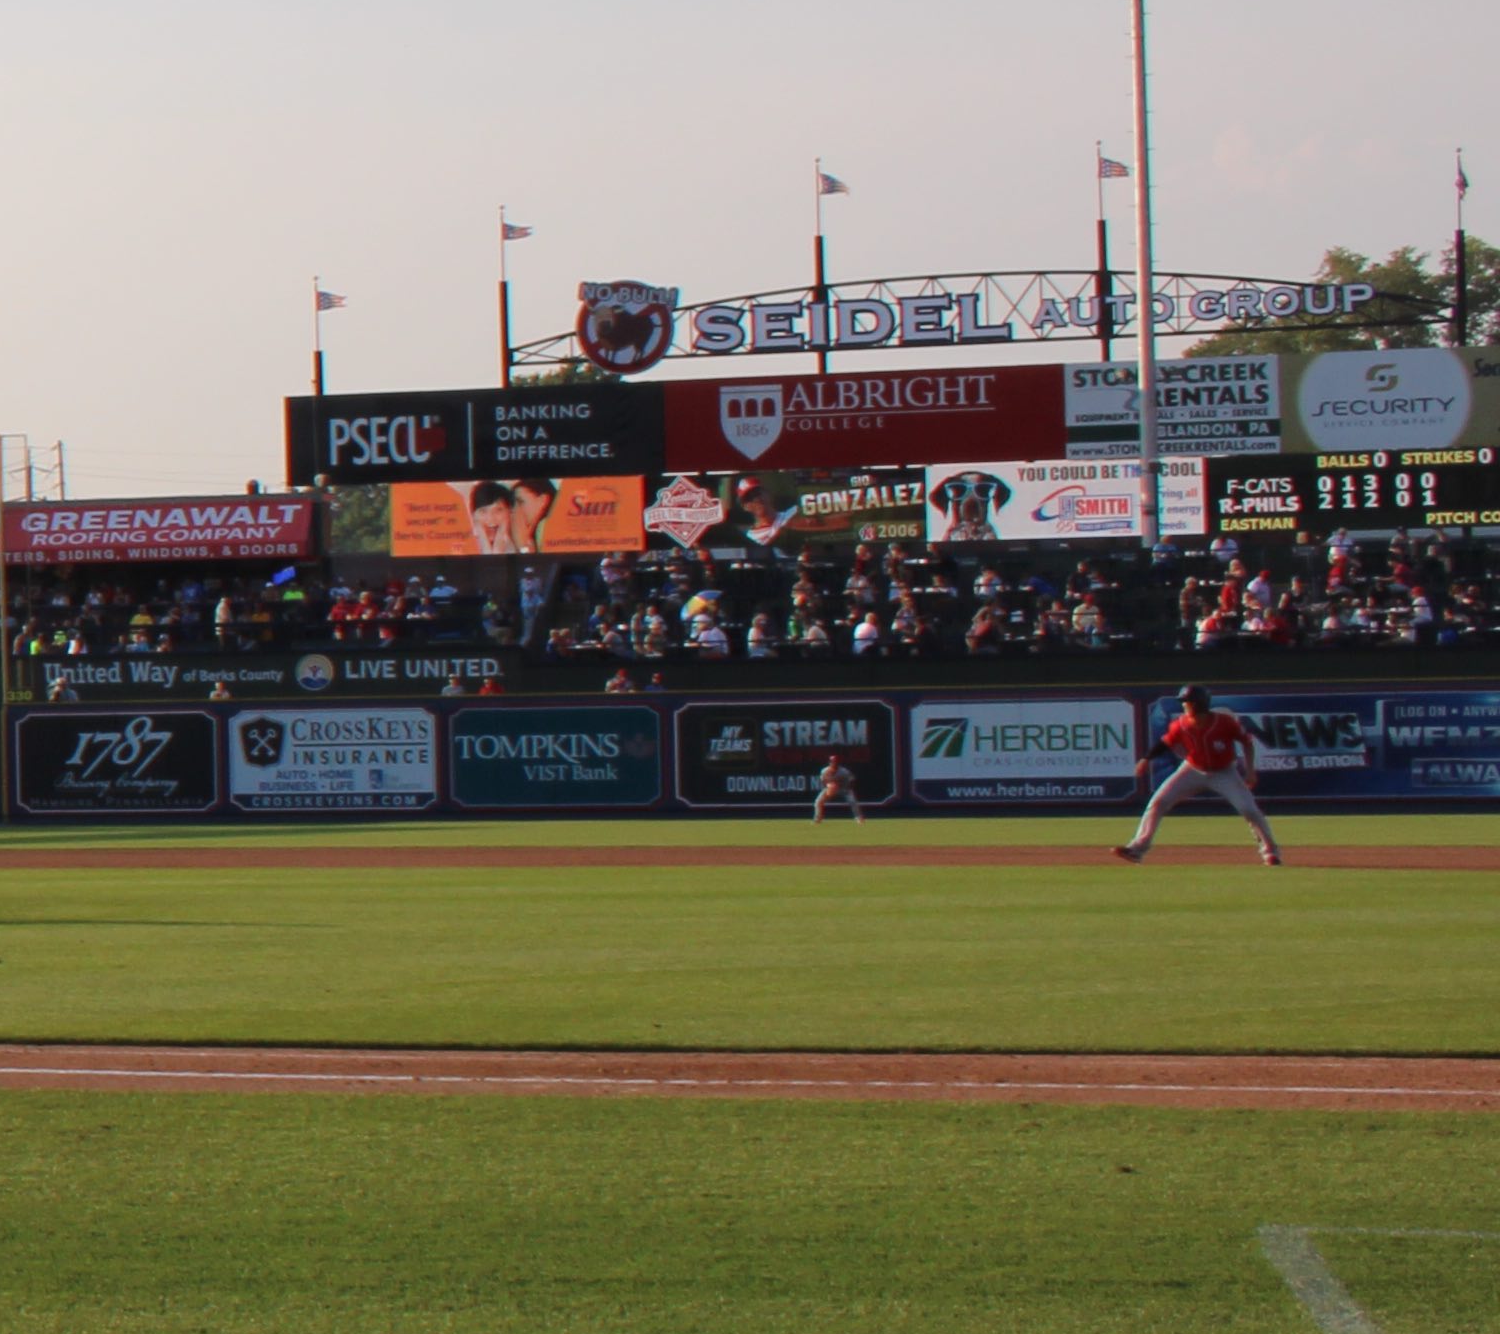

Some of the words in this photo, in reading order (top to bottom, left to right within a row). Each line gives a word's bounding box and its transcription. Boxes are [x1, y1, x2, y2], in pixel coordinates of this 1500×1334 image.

[693, 293, 1011, 354] SEIDEL
[1031, 294, 1175, 328] AUTO
[1189, 283, 1375, 321] GROUP
[1183, 362, 1267, 384] CREEK
[785, 374, 995, 412] ALBRIGHT
[495, 403, 591, 421] BANKING
[1312, 397, 1455, 416] SECURITY
[496, 425, 527, 441] ON
[533, 425, 547, 440] A
[736, 423, 769, 438] 1856
[786, 417, 884, 431] COLLEGE
[1249, 422, 1269, 434] PA
[1317, 454, 1370, 468] BALLS
[1373, 450, 1389, 468] 0
[1401, 450, 1475, 466] STRIKES
[1479, 447, 1495, 465] 0
[1017, 467, 1046, 482] YOU
[1050, 465, 1097, 481] COULD
[1101, 464, 1119, 480] BE
[1226, 477, 1293, 495] F-CATS
[1318, 475, 1333, 492] 0
[1342, 475, 1356, 491] 1
[1363, 474, 1379, 491] 3
[1395, 473, 1411, 489] 0
[1421, 472, 1436, 488] 0
[568, 494, 618, 518] Sun
[800, 482, 925, 515] GONZALEZ
[1075, 499, 1128, 515] SMITH
[1218, 495, 1301, 514] R-PHILS
[1318, 493, 1334, 509] 2
[1342, 492, 1356, 508] 1
[1364, 492, 1380, 508] 2
[1395, 490, 1411, 507] 0
[1422, 490, 1437, 506] 1
[21, 504, 303, 533] GREENAWALT
[1220, 516, 1295, 532] EASTMAN
[1426, 511, 1476, 525] PITCH
[31, 530, 147, 546] ROOFING
[153, 526, 282, 543] COMPANY
[878, 523, 918, 539] 2006
[240, 543, 299, 556] DOORS
[43, 662, 123, 685] United
[129, 661, 178, 688] Way
[183, 670, 196, 682] of
[199, 669, 236, 683] Berks
[239, 669, 284, 683] County
[345, 660, 396, 679] LIVE
[6, 689, 33, 702] 330
[721, 725, 743, 739] MY
[762, 719, 868, 748] STREAM
[973, 722, 1129, 752] HERBEIN
[65, 717, 173, 779] 1787
[454, 734, 620, 764] TOMPKINS
[710, 738, 753, 753] TEAMS
[292, 749, 429, 765] INSURANCE
[1302, 753, 1366, 769] EDITION
[275, 770, 308, 780] AUTO
[318, 769, 354, 779] HOME
[523, 765, 568, 781] VIST
[572, 764, 619, 781] Bank
[259, 781, 317, 792] BUSINESS
[329, 780, 355, 791] LIFE
[726, 775, 806, 793] DOWNLOAD
[947, 782, 1105, 798] www.herbein.com
